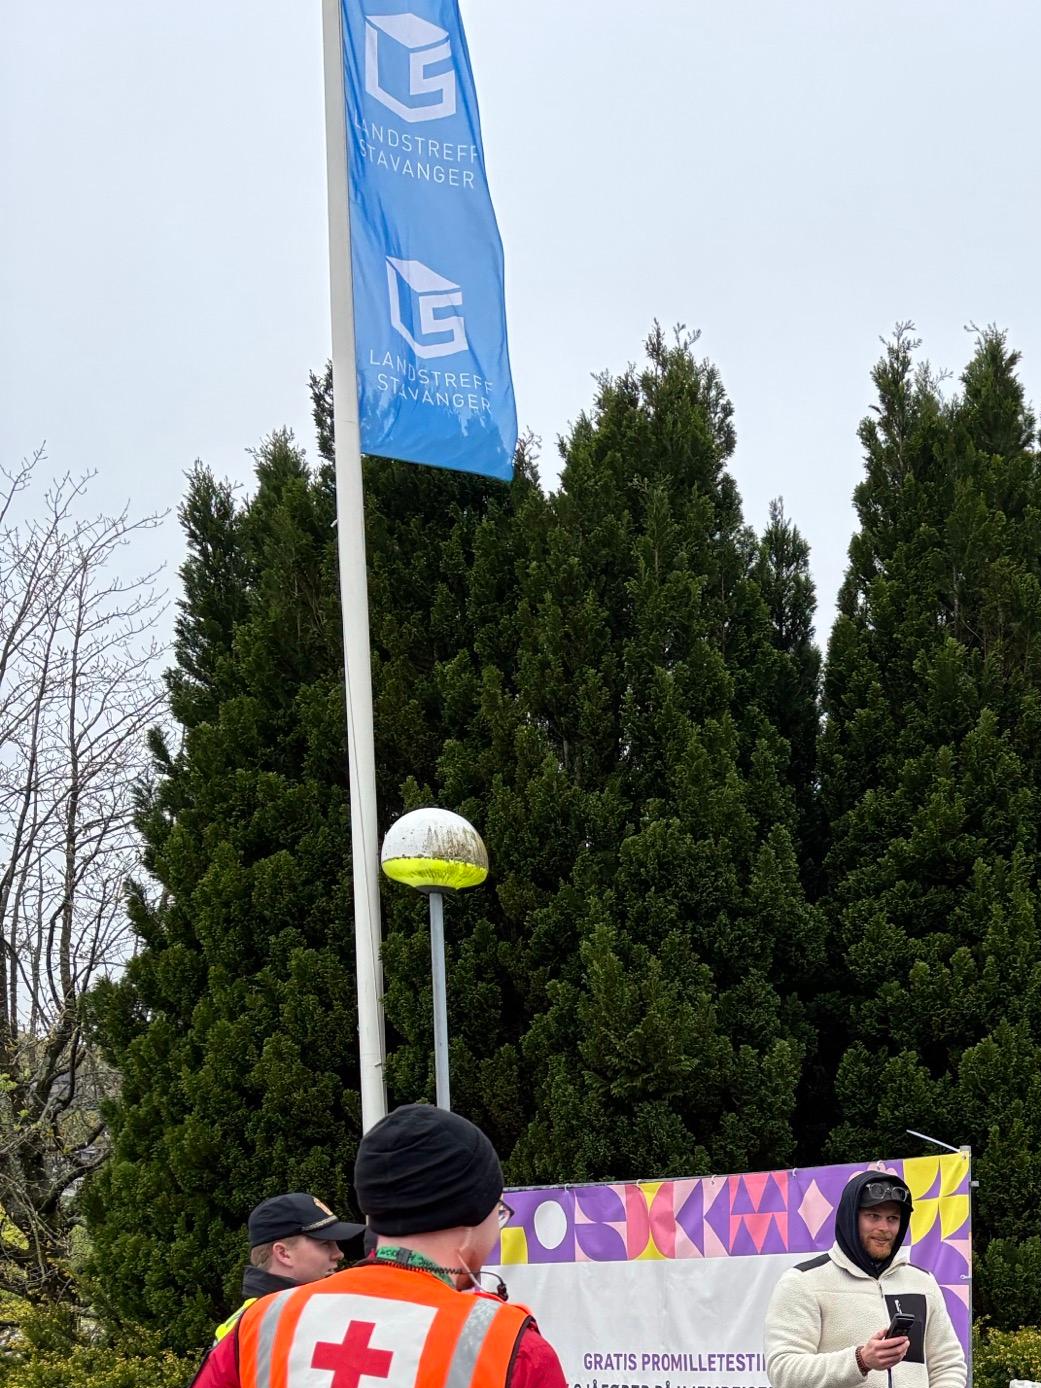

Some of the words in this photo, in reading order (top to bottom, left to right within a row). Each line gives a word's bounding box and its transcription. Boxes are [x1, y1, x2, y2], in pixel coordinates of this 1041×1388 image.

[359, 138, 475, 189] STAVANGER
[369, 349, 494, 394] LANDSTREFF
[377, 373, 492, 415] STAVANGER
[583, 1352, 638, 1371] GRATIS
